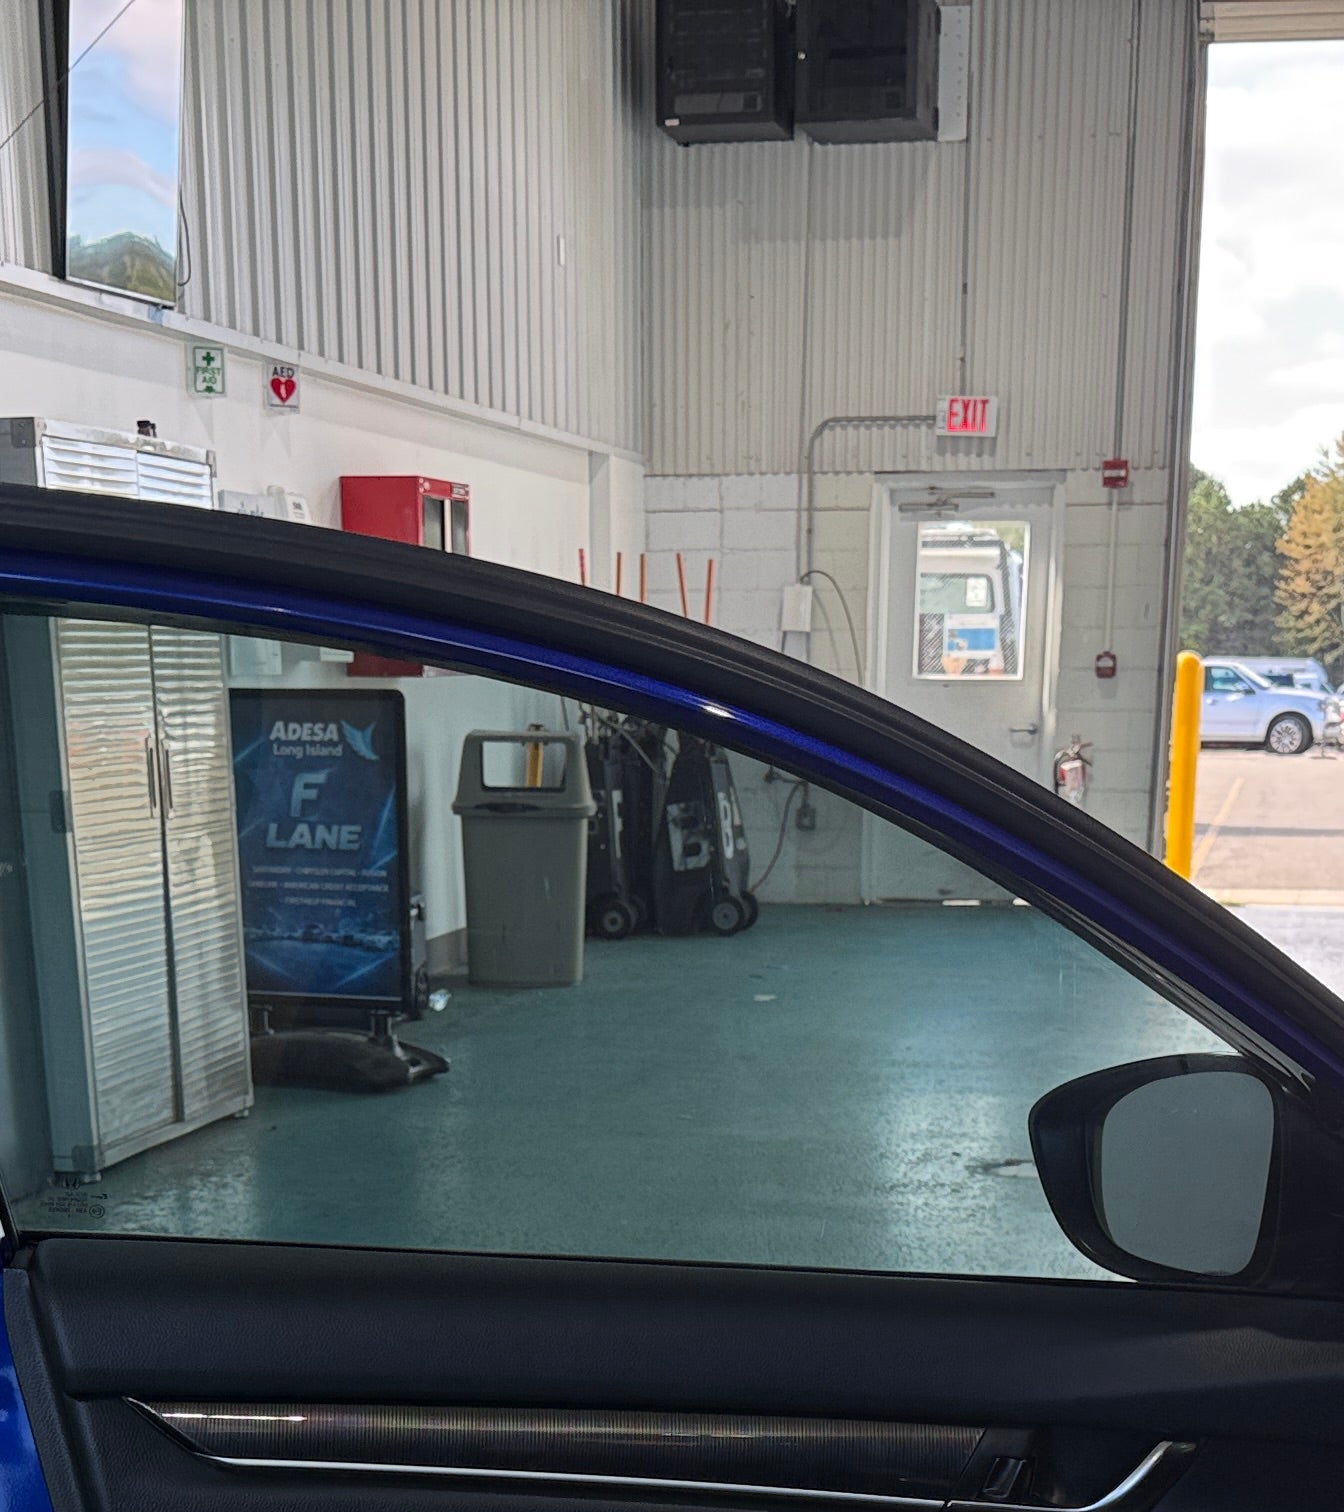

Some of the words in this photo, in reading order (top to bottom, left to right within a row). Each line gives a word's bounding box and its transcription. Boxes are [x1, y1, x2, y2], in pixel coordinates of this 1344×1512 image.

[272, 366, 295, 379] AED
[946, 397, 990, 433] EXIT
[269, 720, 339, 742] ADESA
[273, 743, 304, 759] Long
[306, 744, 343, 757] Island
[290, 769, 329, 818] F
[266, 822, 362, 850] LANE
